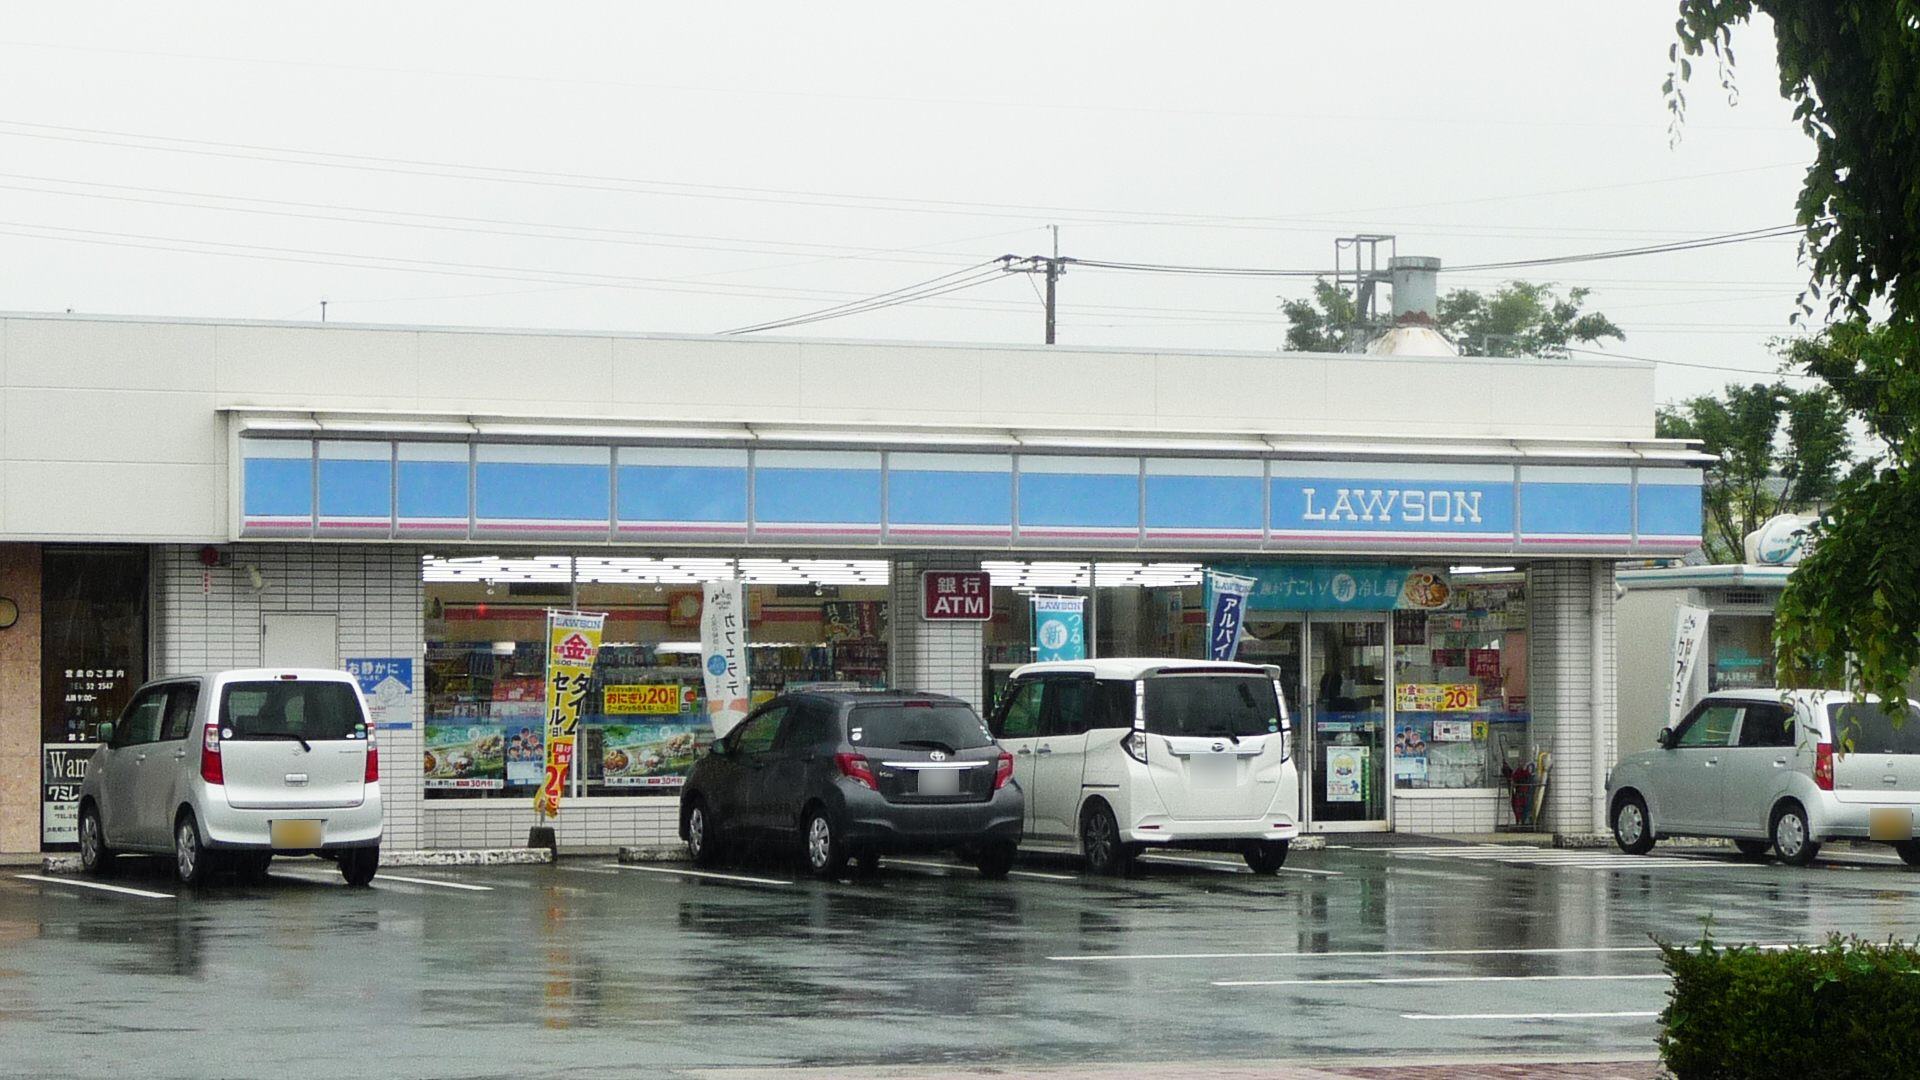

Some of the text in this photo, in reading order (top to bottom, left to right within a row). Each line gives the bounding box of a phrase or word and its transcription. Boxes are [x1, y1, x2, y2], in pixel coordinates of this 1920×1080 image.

[1303, 488, 1482, 523] LAWSON
[937, 577, 980, 594] 銀行
[934, 596, 984, 614] ATM
[1037, 601, 1081, 610] LAWSON
[556, 618, 602, 629] LAWSON
[1215, 598, 1237, 660] アルバイ
[348, 662, 399, 675] お静かに
